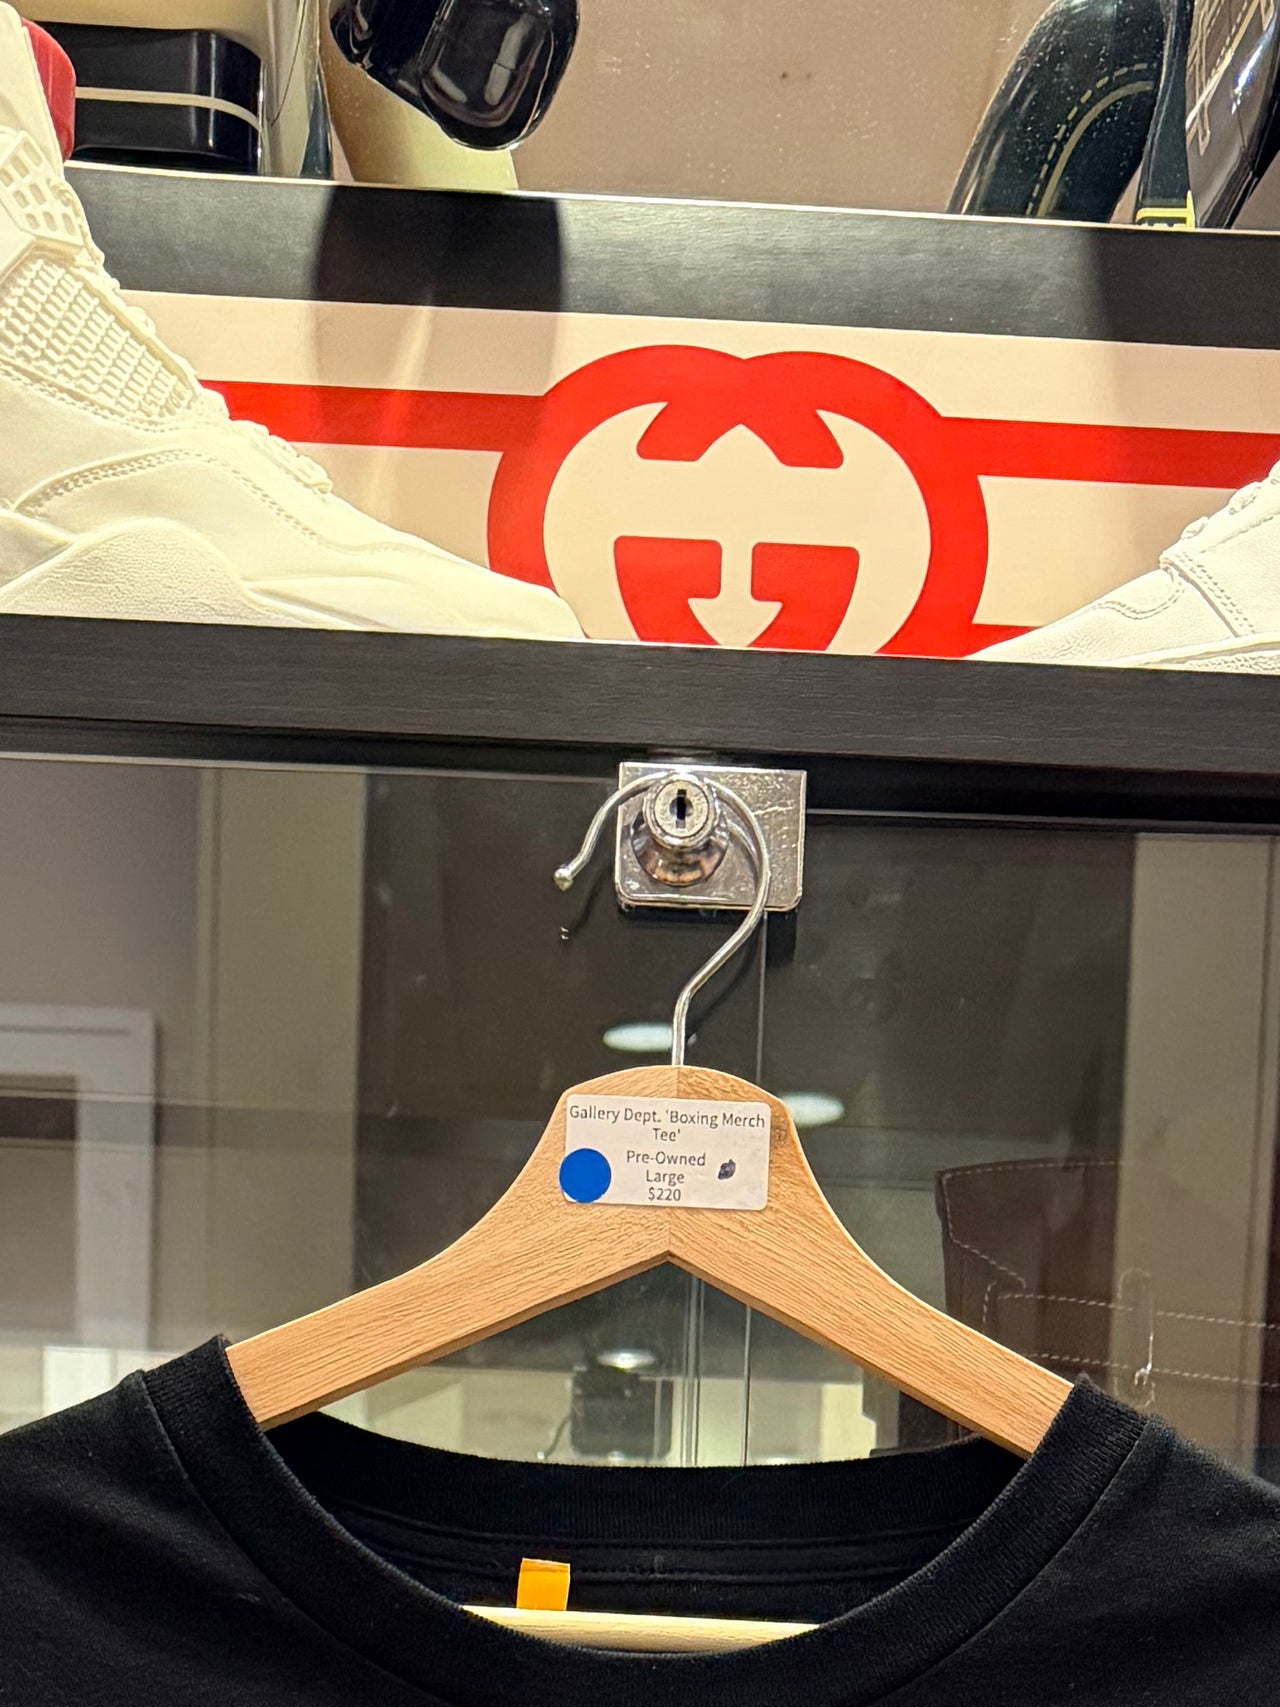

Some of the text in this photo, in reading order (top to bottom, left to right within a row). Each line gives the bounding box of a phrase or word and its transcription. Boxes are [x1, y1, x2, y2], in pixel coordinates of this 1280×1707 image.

[569, 1104, 620, 1123] Gallery
[624, 1108, 661, 1125] Dept.
[722, 1113, 765, 1128] Merch
[652, 1128, 681, 1142] Tee'
[626, 1150, 706, 1167] Pre-Owned
[646, 1169, 685, 1186] Large
[648, 1188, 681, 1202] $220
